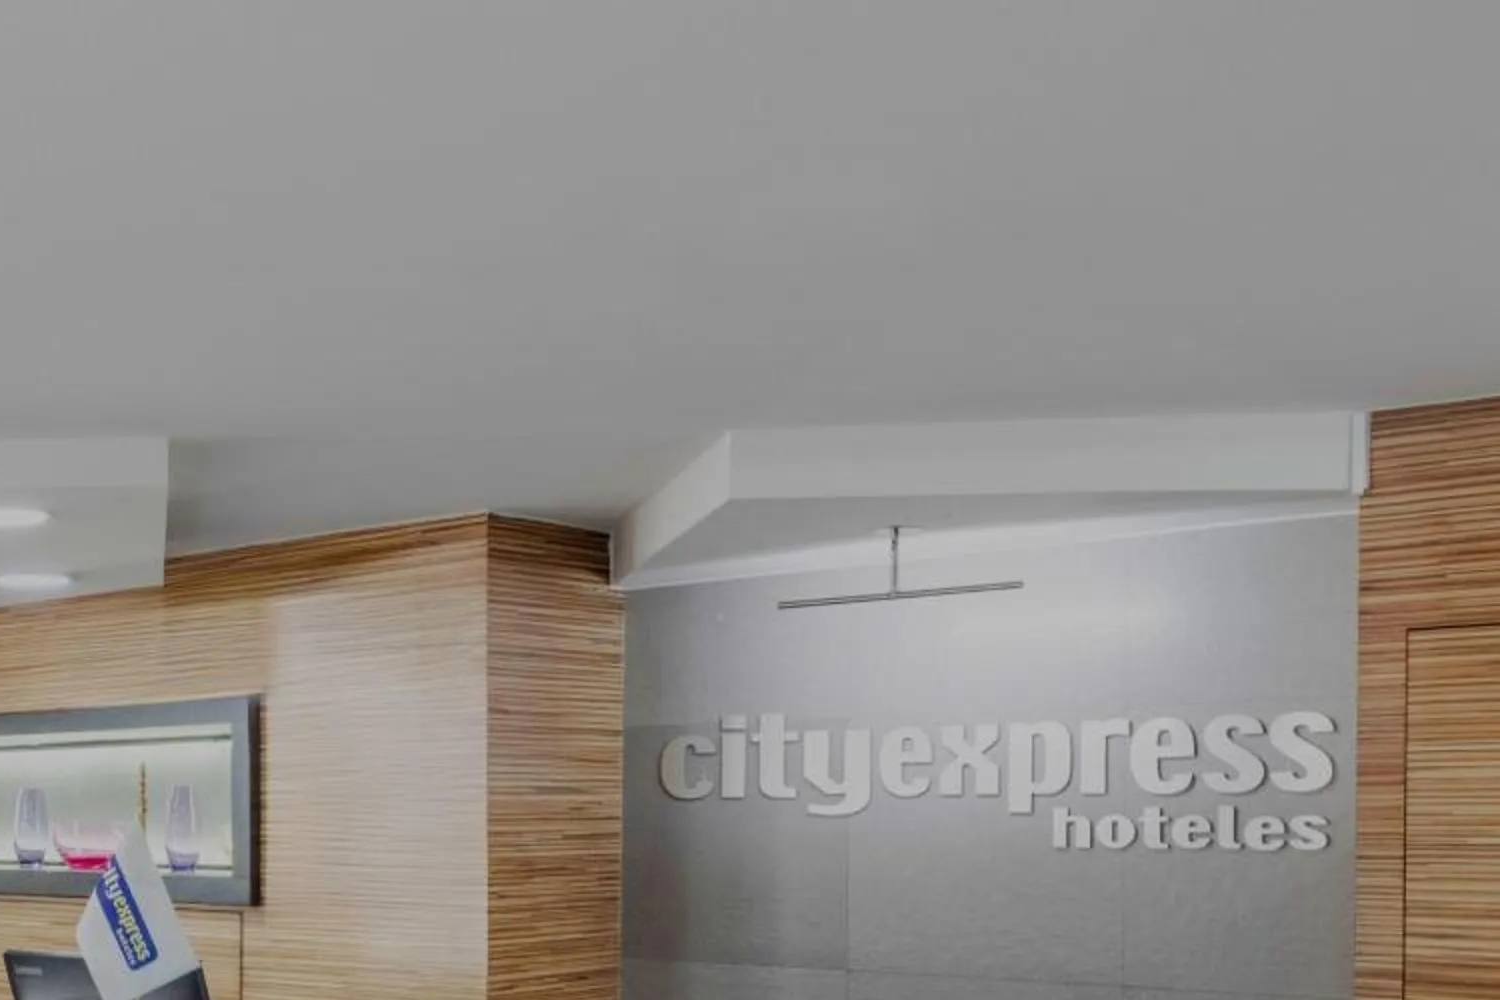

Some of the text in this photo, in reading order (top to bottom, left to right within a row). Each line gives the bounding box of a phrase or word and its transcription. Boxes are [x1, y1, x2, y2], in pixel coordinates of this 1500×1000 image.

[659, 711, 1337, 816] cityexpress
[1052, 805, 1331, 850] hoteles
[103, 867, 151, 961] ityexpress
